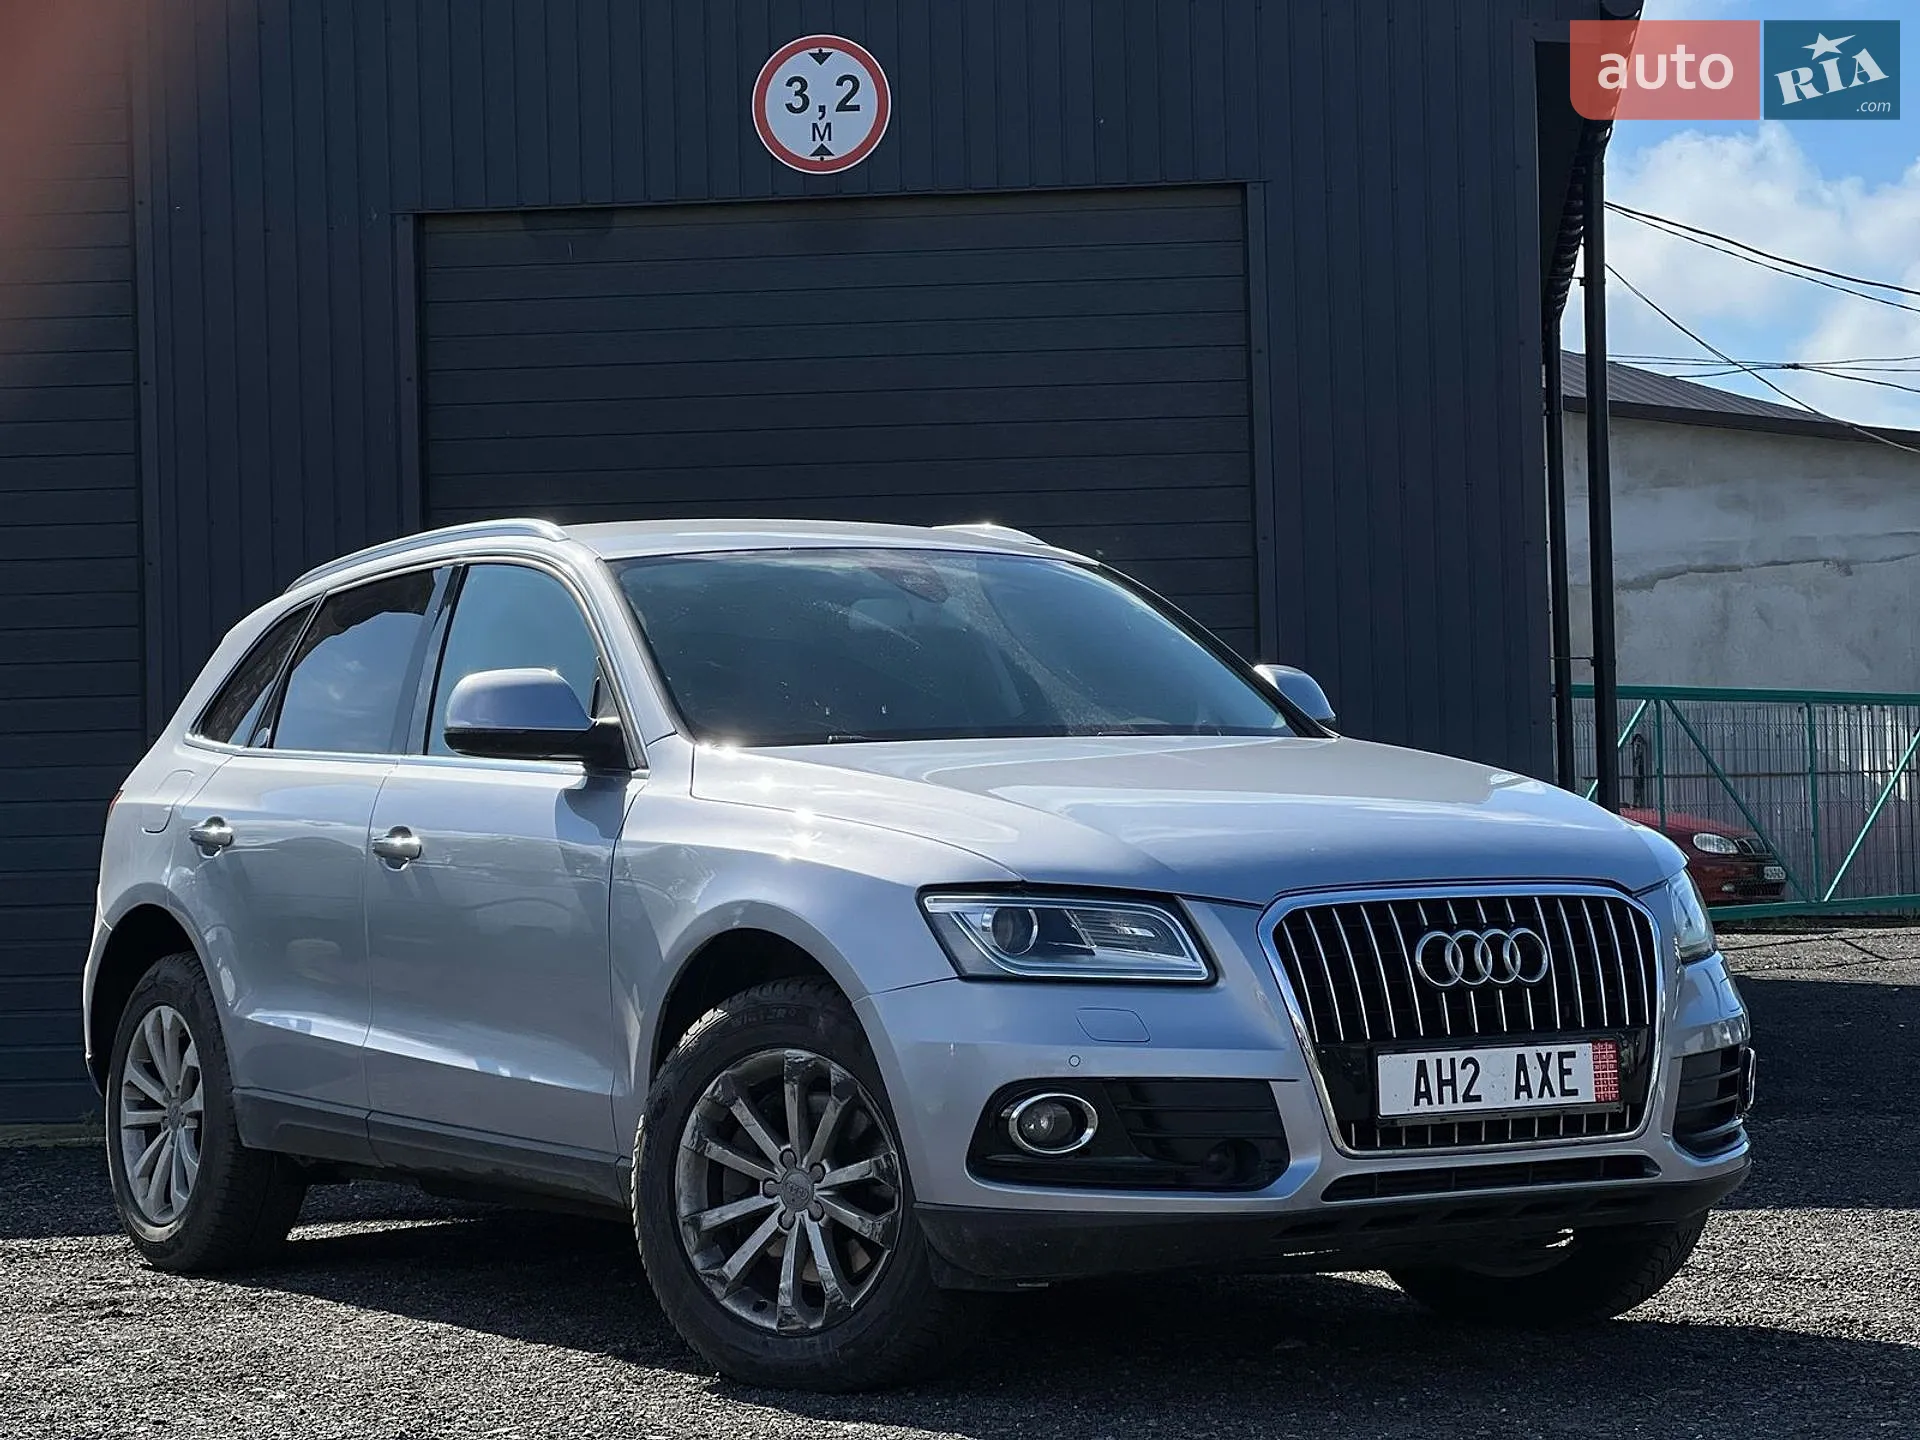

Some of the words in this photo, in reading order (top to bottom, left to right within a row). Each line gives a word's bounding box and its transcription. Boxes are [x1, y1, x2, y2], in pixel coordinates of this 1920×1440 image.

[784, 74, 861, 121] 3,2
[1413, 1056, 1482, 1107] AH2
[1514, 1051, 1579, 1101] AXE
